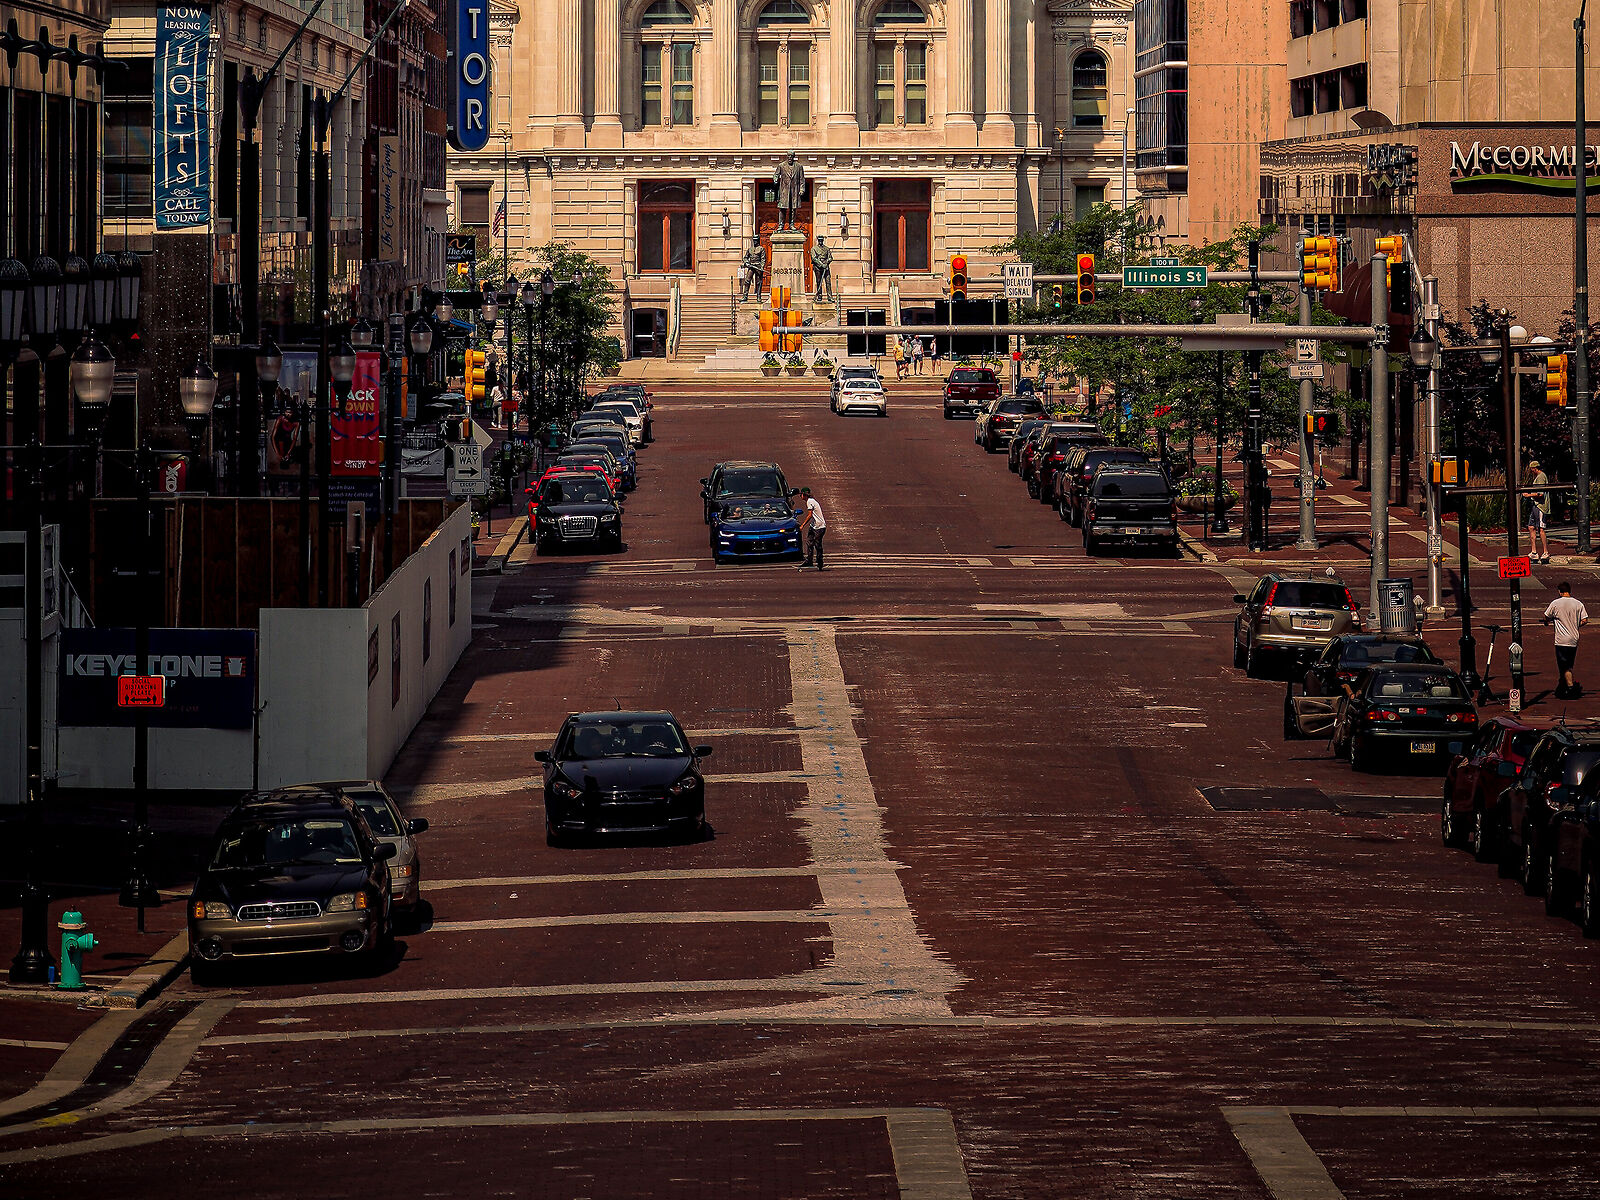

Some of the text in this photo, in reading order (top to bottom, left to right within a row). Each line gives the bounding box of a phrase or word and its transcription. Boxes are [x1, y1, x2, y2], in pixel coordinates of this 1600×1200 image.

[165, 6, 203, 18] NOW
[165, 20, 201, 30] LEASING
[169, 46, 192, 184] LOFTS
[165, 199, 201, 210] CALL
[165, 213, 200, 223] TODAY
[773, 267, 802, 275] MORTON
[1008, 266, 1030, 277] WAIT
[1128, 271, 1202, 283] Illinois St
[1007, 278, 1032, 287] DELAYED
[1008, 287, 1030, 296] SIGNAL
[336, 389, 375, 401] ACK
[459, 446, 478, 456] ONE
[460, 456, 479, 465] WAY
[66, 654, 222, 677] KEYSTONE
